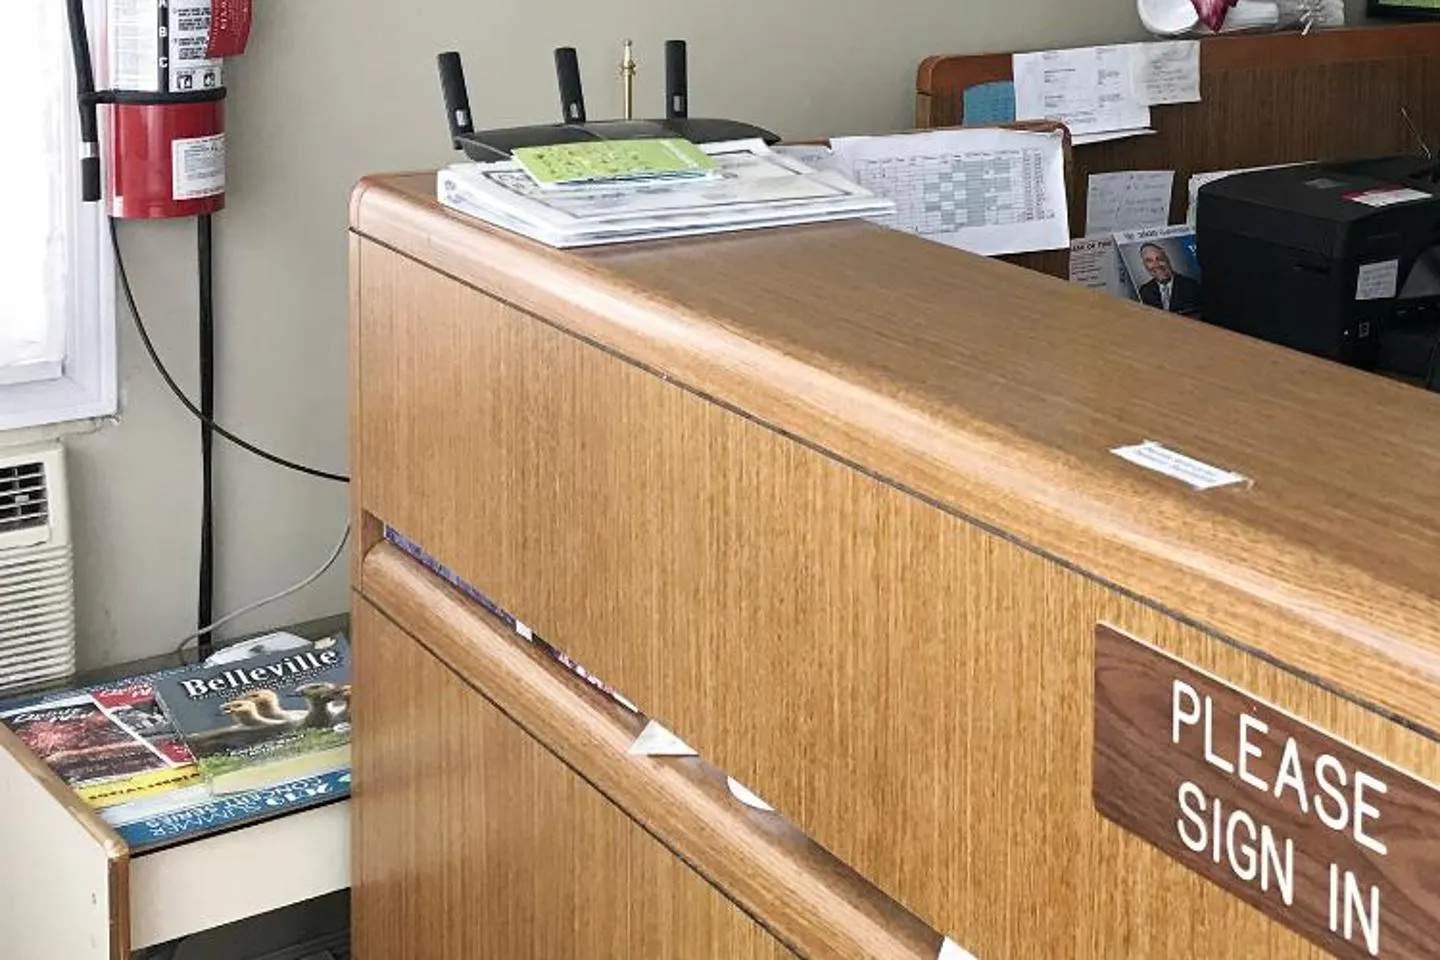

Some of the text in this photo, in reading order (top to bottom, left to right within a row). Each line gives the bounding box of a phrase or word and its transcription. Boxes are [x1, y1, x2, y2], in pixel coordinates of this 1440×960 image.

[159, 26, 168, 38] B
[159, 56, 168, 68] C
[181, 649, 338, 697] Belleville
[1171, 679, 1388, 855] PLEASE
[1176, 780, 1380, 957] SIGN IN
